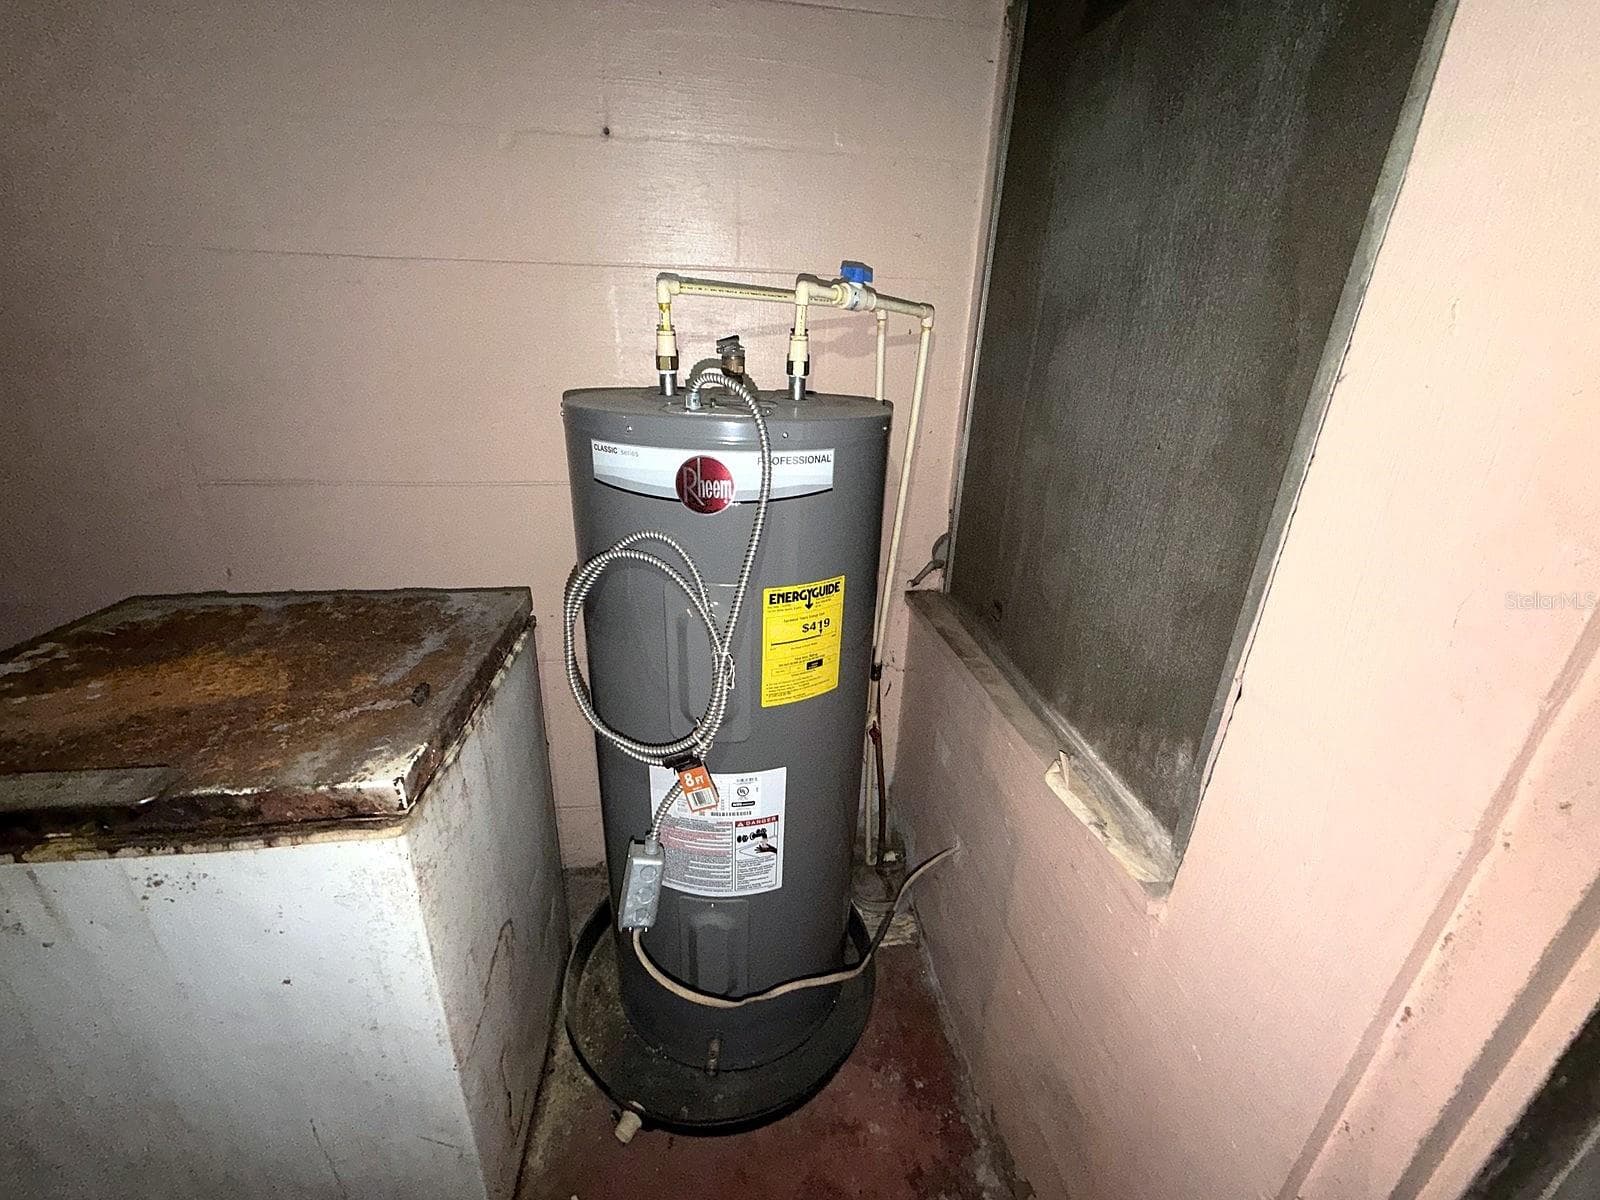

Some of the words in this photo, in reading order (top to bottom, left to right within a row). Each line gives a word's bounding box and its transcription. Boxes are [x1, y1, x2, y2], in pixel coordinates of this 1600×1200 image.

[594, 443, 618, 454] CLASSIC
[620, 449, 639, 458] series
[757, 454, 832, 466] POFESSIONAL
[682, 457, 732, 507] Rheem
[769, 582, 841, 606] ENERGYGUIDE
[684, 773, 694, 787] 8
[745, 816, 777, 826] DANGER
